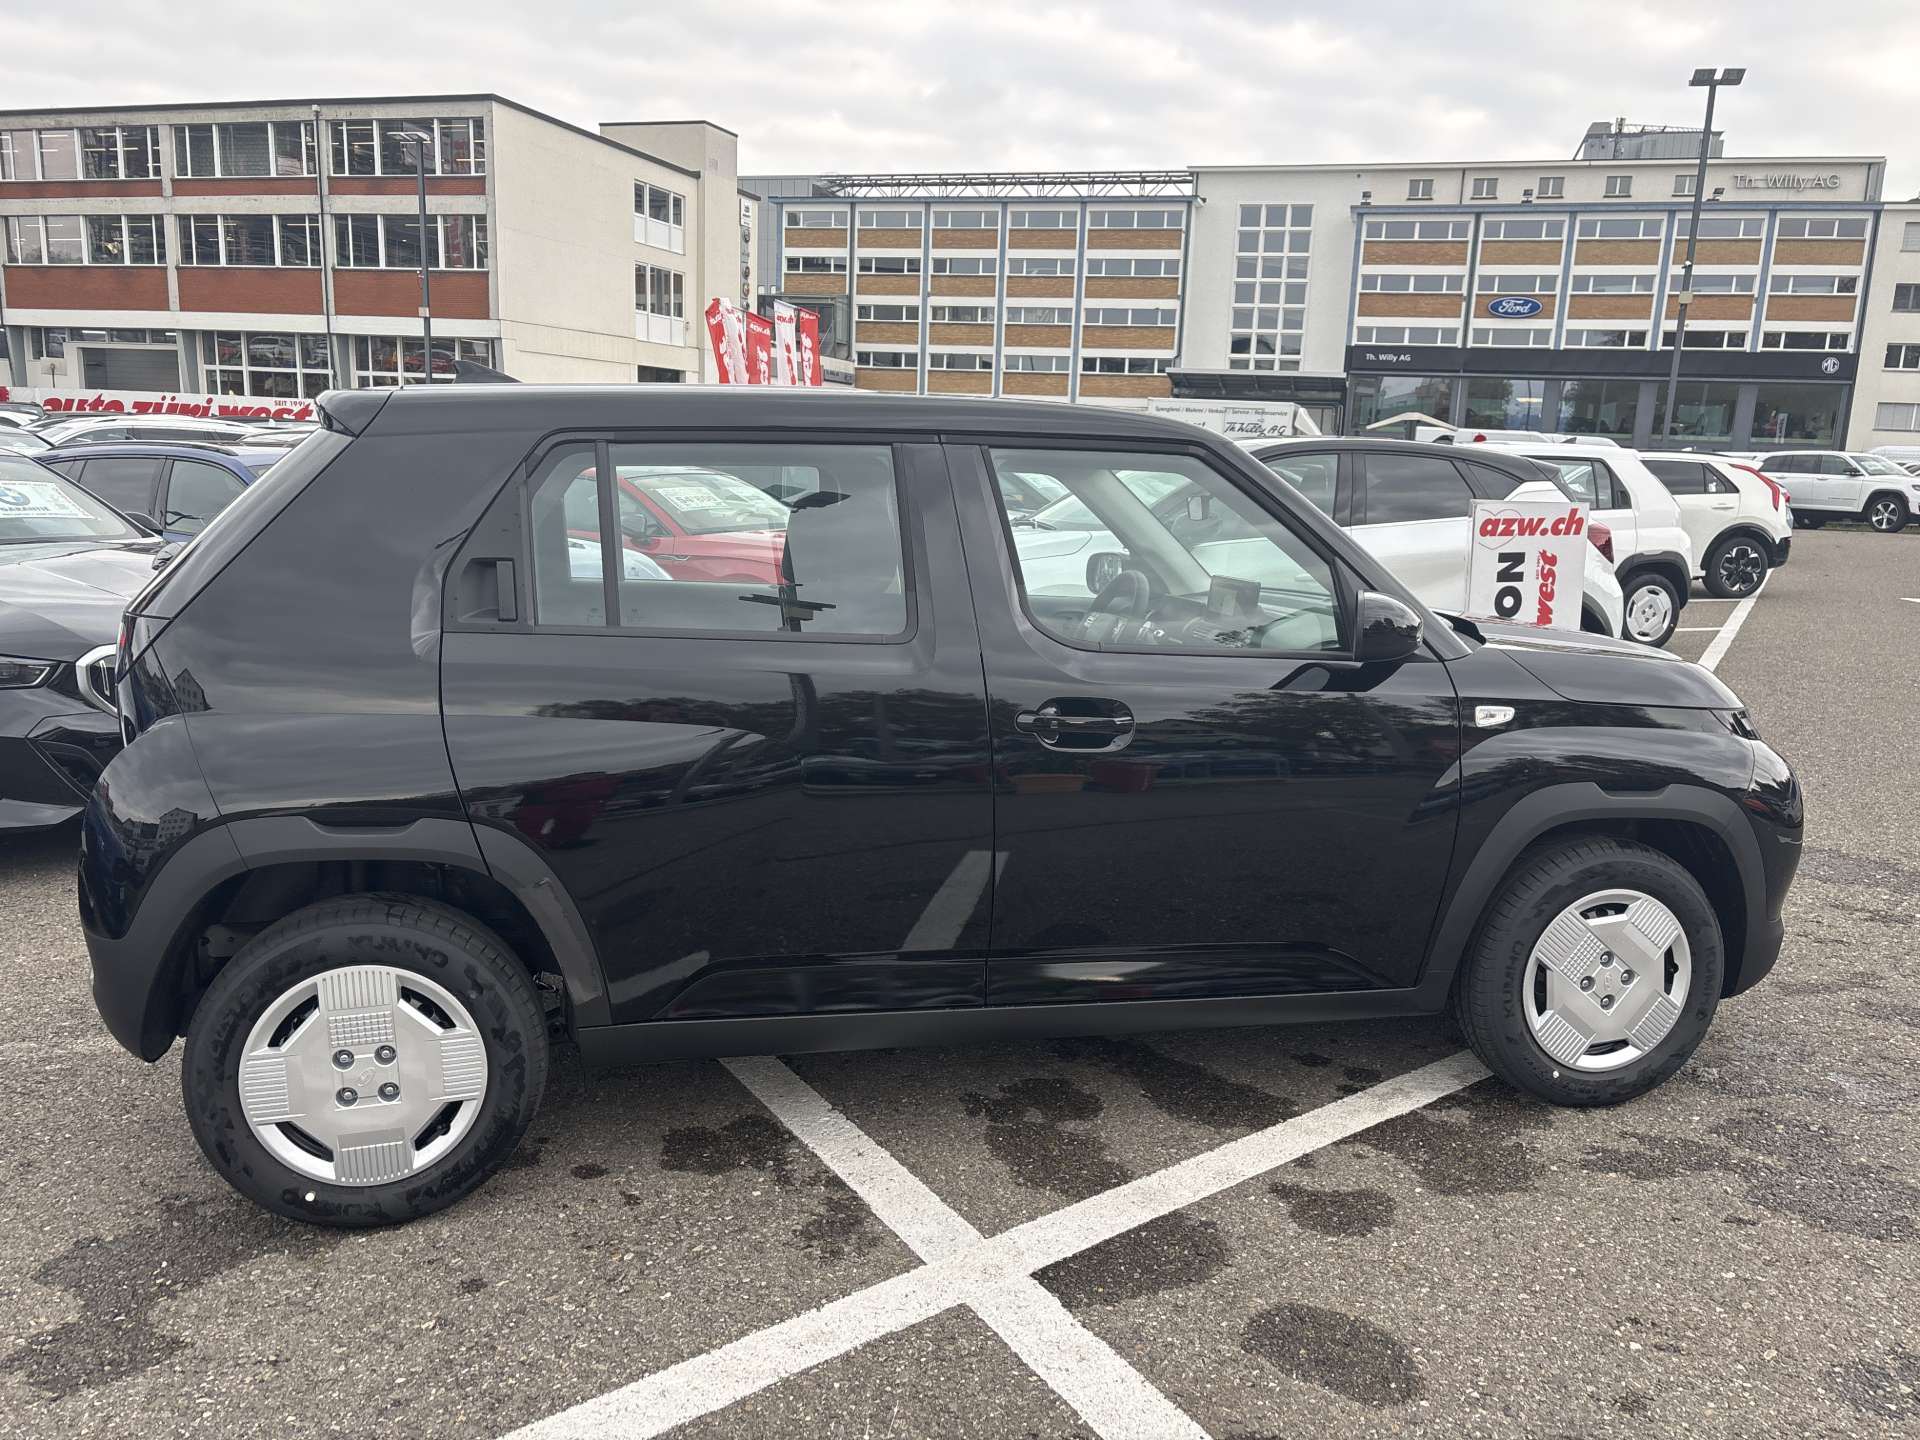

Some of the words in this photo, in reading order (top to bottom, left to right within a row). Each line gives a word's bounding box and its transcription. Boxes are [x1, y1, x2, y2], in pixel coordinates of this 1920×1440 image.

[1767, 173, 1808, 192] Willy
[1813, 174, 1841, 189] AG
[1498, 299, 1531, 314] Ford
[1366, 353, 1377, 361] Th.
[1379, 353, 1398, 362] Willy
[1823, 358, 1838, 373] MG
[43, 393, 125, 413] auto
[132, 395, 213, 418] züri
[218, 403, 314, 421] west
[1267, 425, 1287, 436] AG
[1479, 508, 1585, 538] azw.ch
[1536, 548, 1558, 626] west
[1502, 938, 1525, 1018] KUMHO
